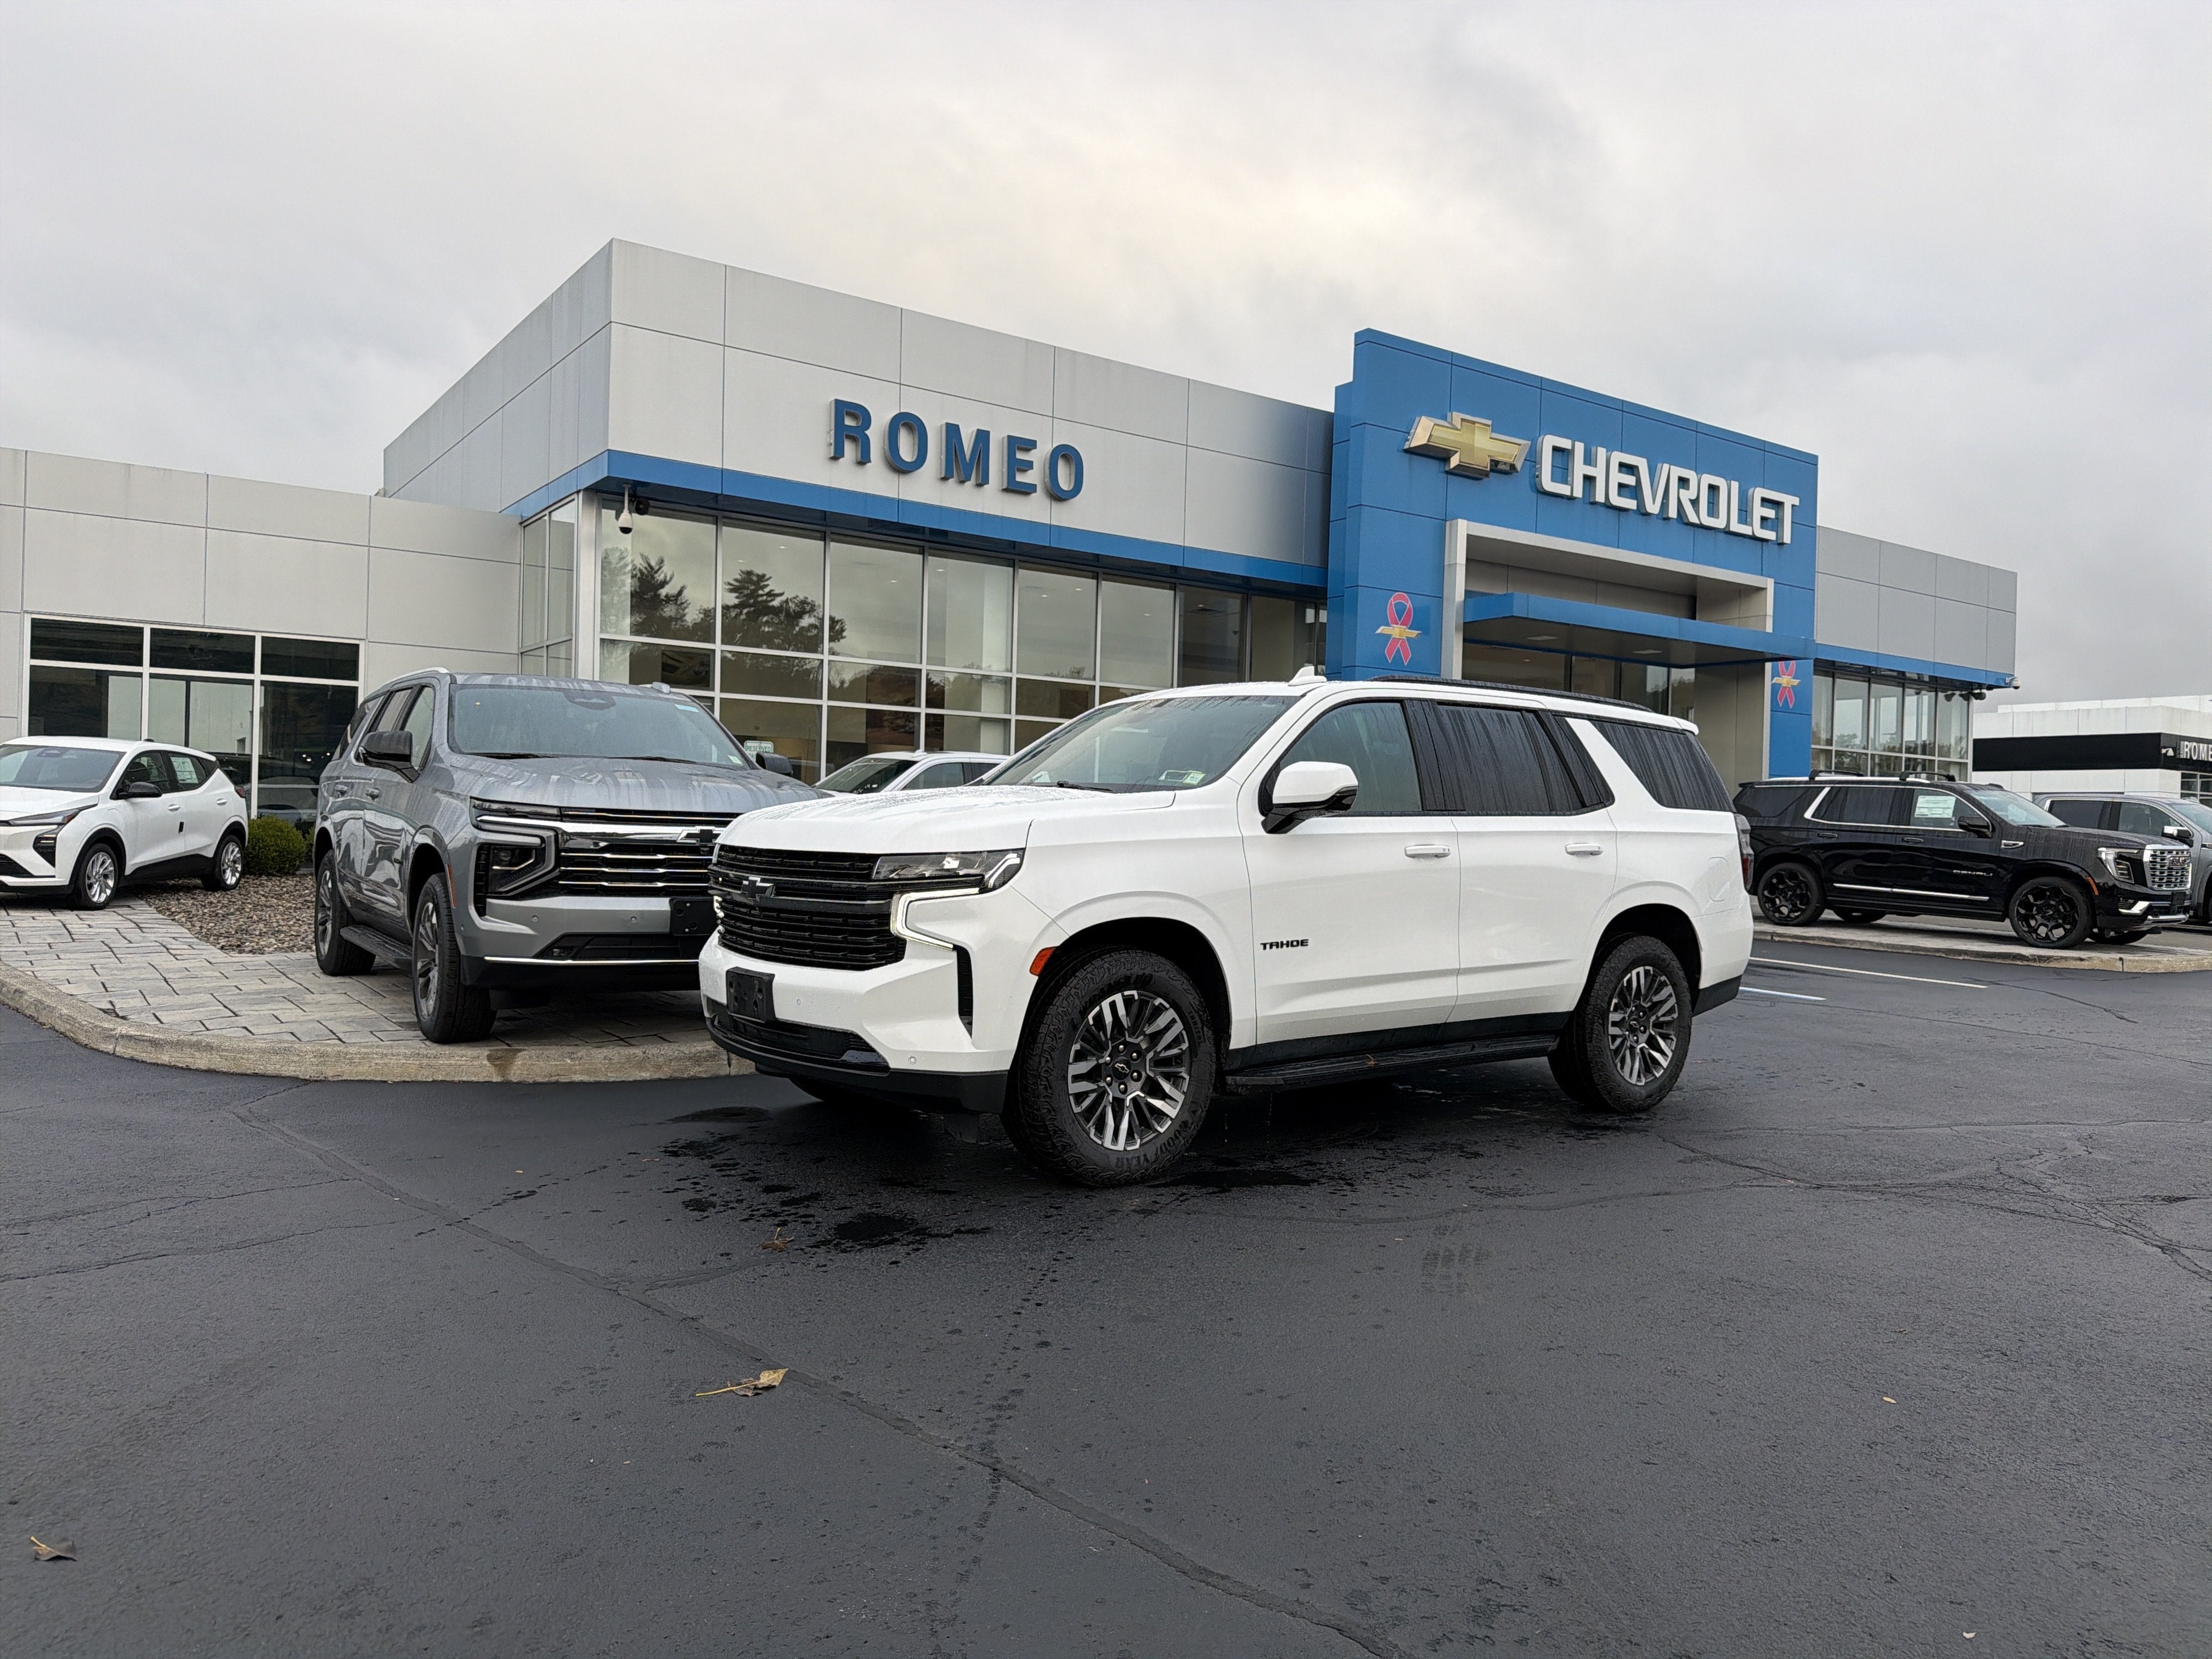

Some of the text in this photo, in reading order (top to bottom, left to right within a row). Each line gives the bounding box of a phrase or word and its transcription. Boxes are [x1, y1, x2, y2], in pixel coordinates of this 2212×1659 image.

[830, 398, 1084, 501] ROMEO
[1537, 435, 1800, 545] CHEVROLET
[1260, 939, 1309, 950] TAHOE
